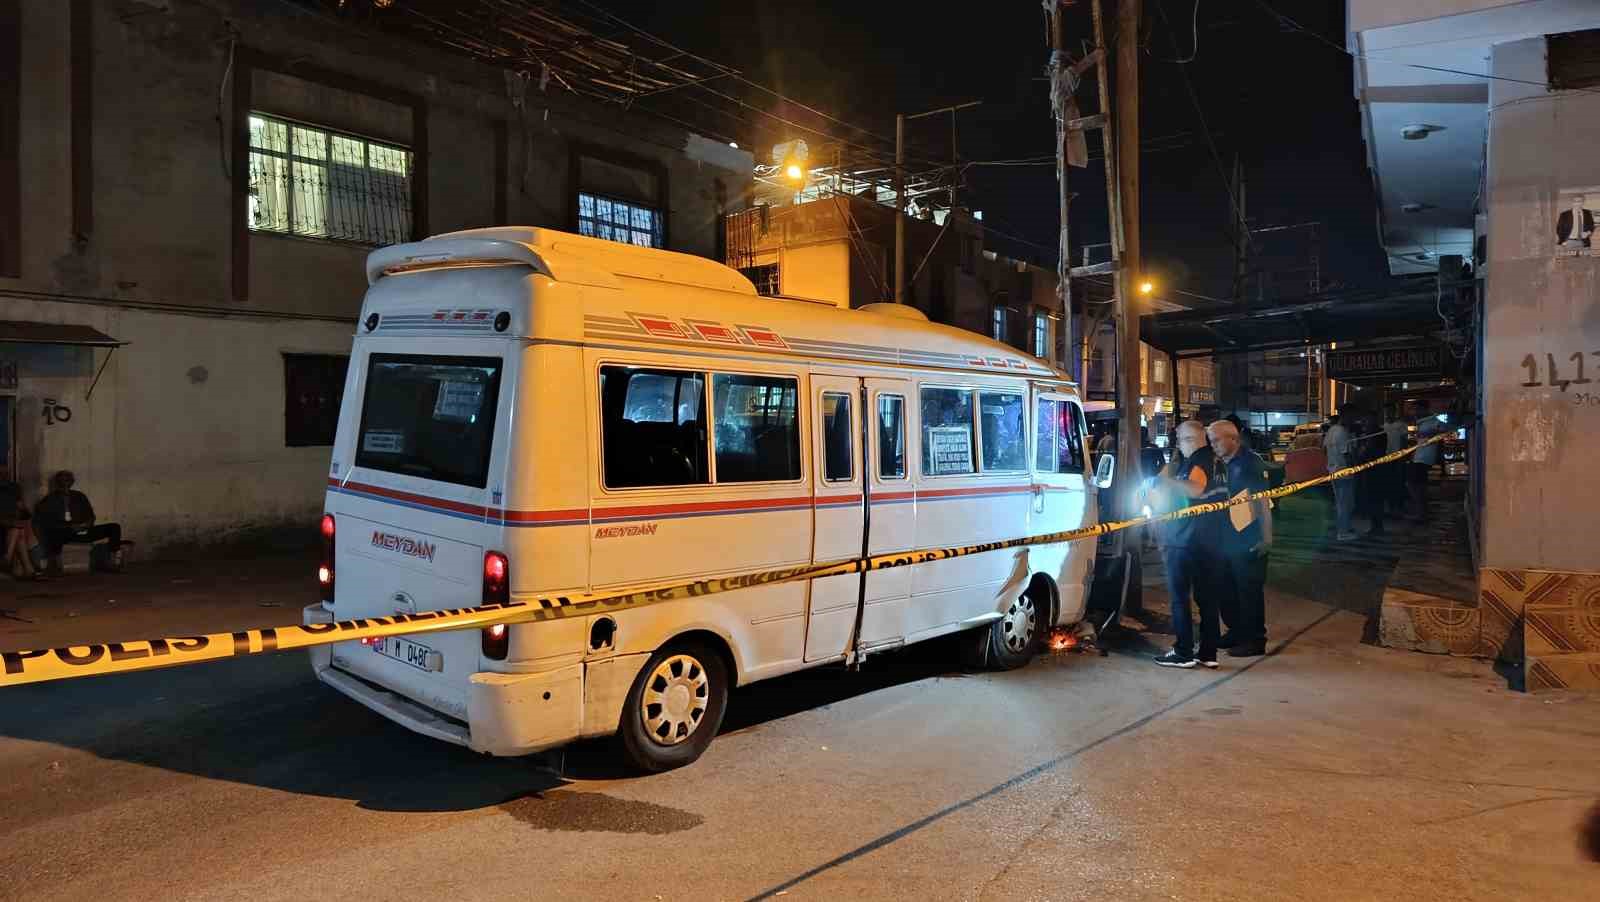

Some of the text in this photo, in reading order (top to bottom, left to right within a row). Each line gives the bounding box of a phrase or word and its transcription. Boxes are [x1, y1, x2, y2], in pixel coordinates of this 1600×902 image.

[595, 523, 657, 539] MEYDAN
[371, 530, 435, 562] MEYDAN
[395, 639, 401, 658] M
